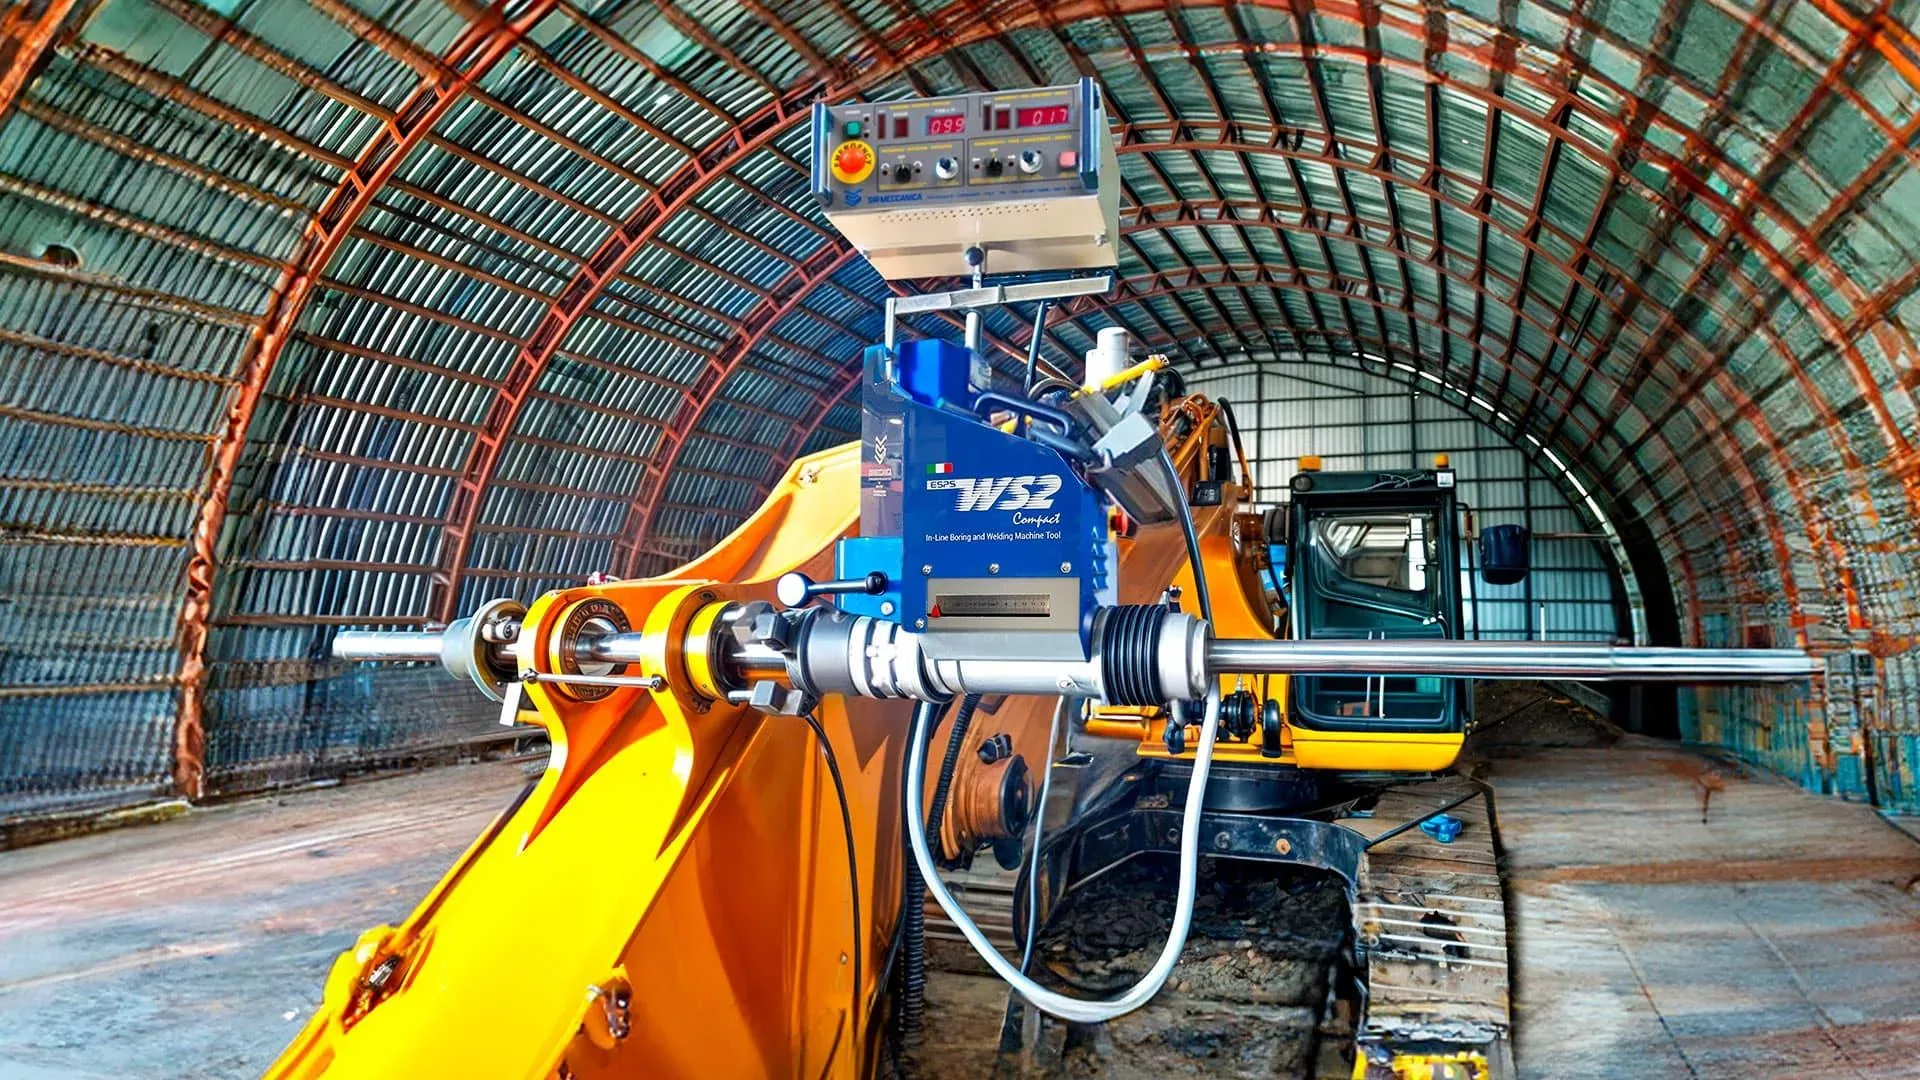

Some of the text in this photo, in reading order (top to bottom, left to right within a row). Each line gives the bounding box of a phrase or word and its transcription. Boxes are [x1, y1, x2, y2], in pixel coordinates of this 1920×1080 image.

[931, 118, 965, 134] 099
[953, 474, 1063, 512] WS2
[1012, 511, 1061, 528] Compact
[925, 531, 1061, 543] In-Line Boring and Welding Machine Tool
